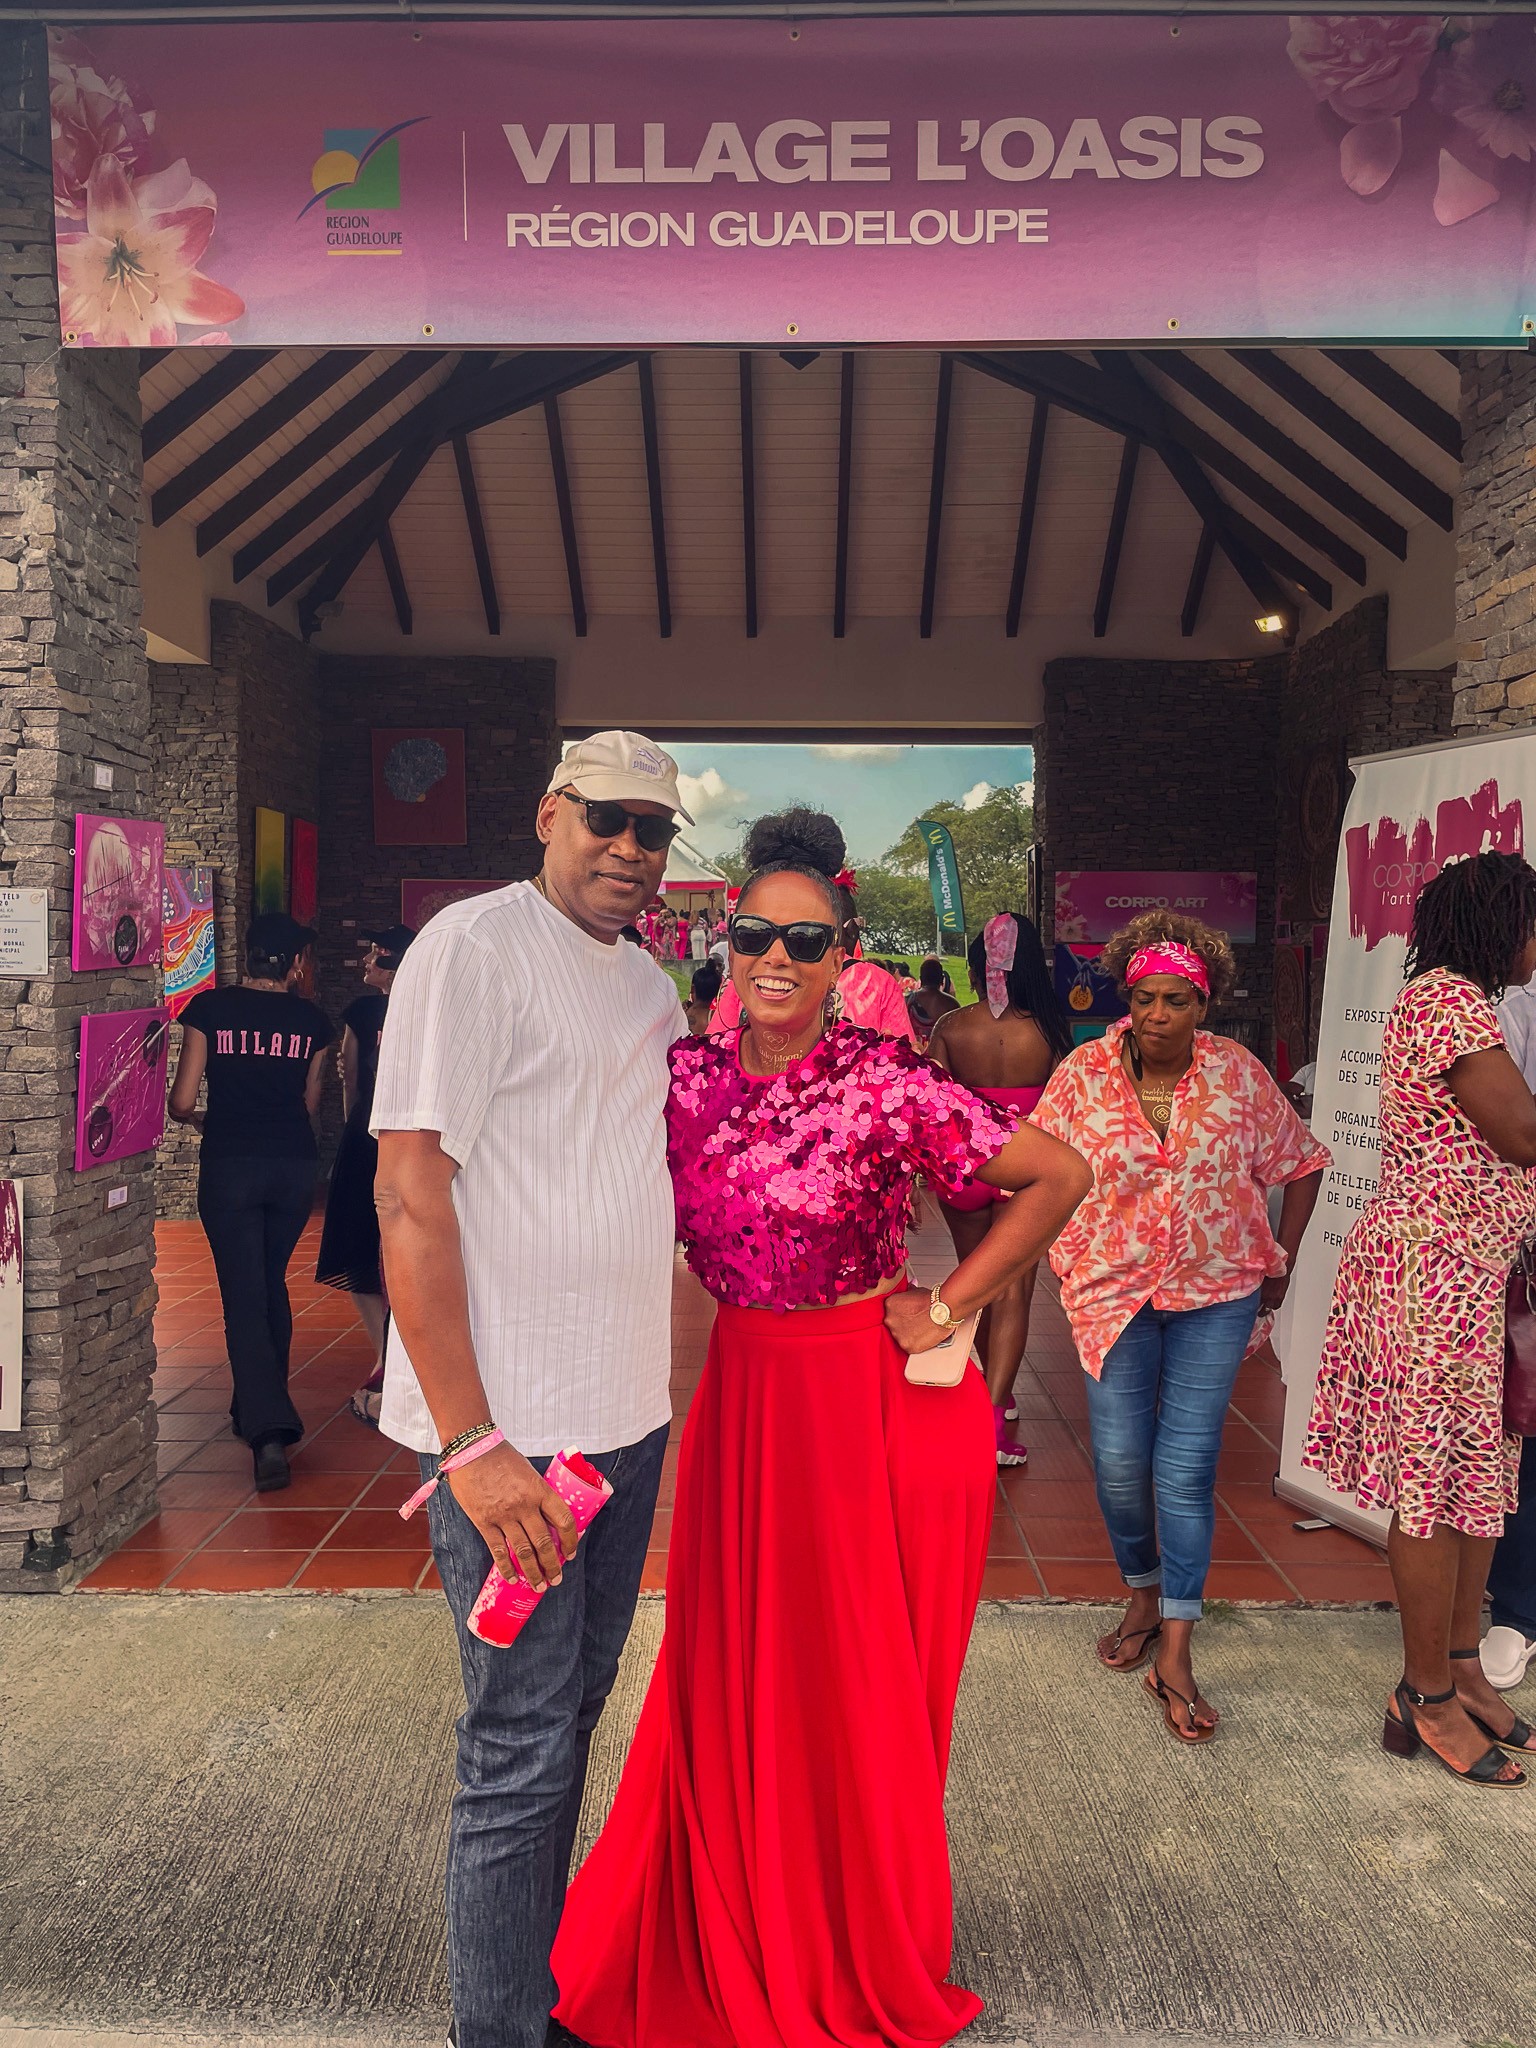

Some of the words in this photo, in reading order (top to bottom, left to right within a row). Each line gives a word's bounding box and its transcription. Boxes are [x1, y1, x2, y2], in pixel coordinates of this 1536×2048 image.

[502, 119, 891, 184] VILLAGE
[917, 116, 1265, 182] L’OASIS
[326, 215, 370, 229] REGION
[507, 204, 695, 248] RÉGION
[708, 208, 1049, 248] GUADELOUPE
[326, 232, 403, 245] GUADELOUPE
[935, 848, 953, 910] McDonald's
[1373, 861, 1440, 888] CORPO
[1105, 896, 1169, 909] CORPO
[1173, 896, 1208, 909] ART
[1339, 1069, 1358, 1084] DES
[1327, 1190, 1340, 1205] DE
